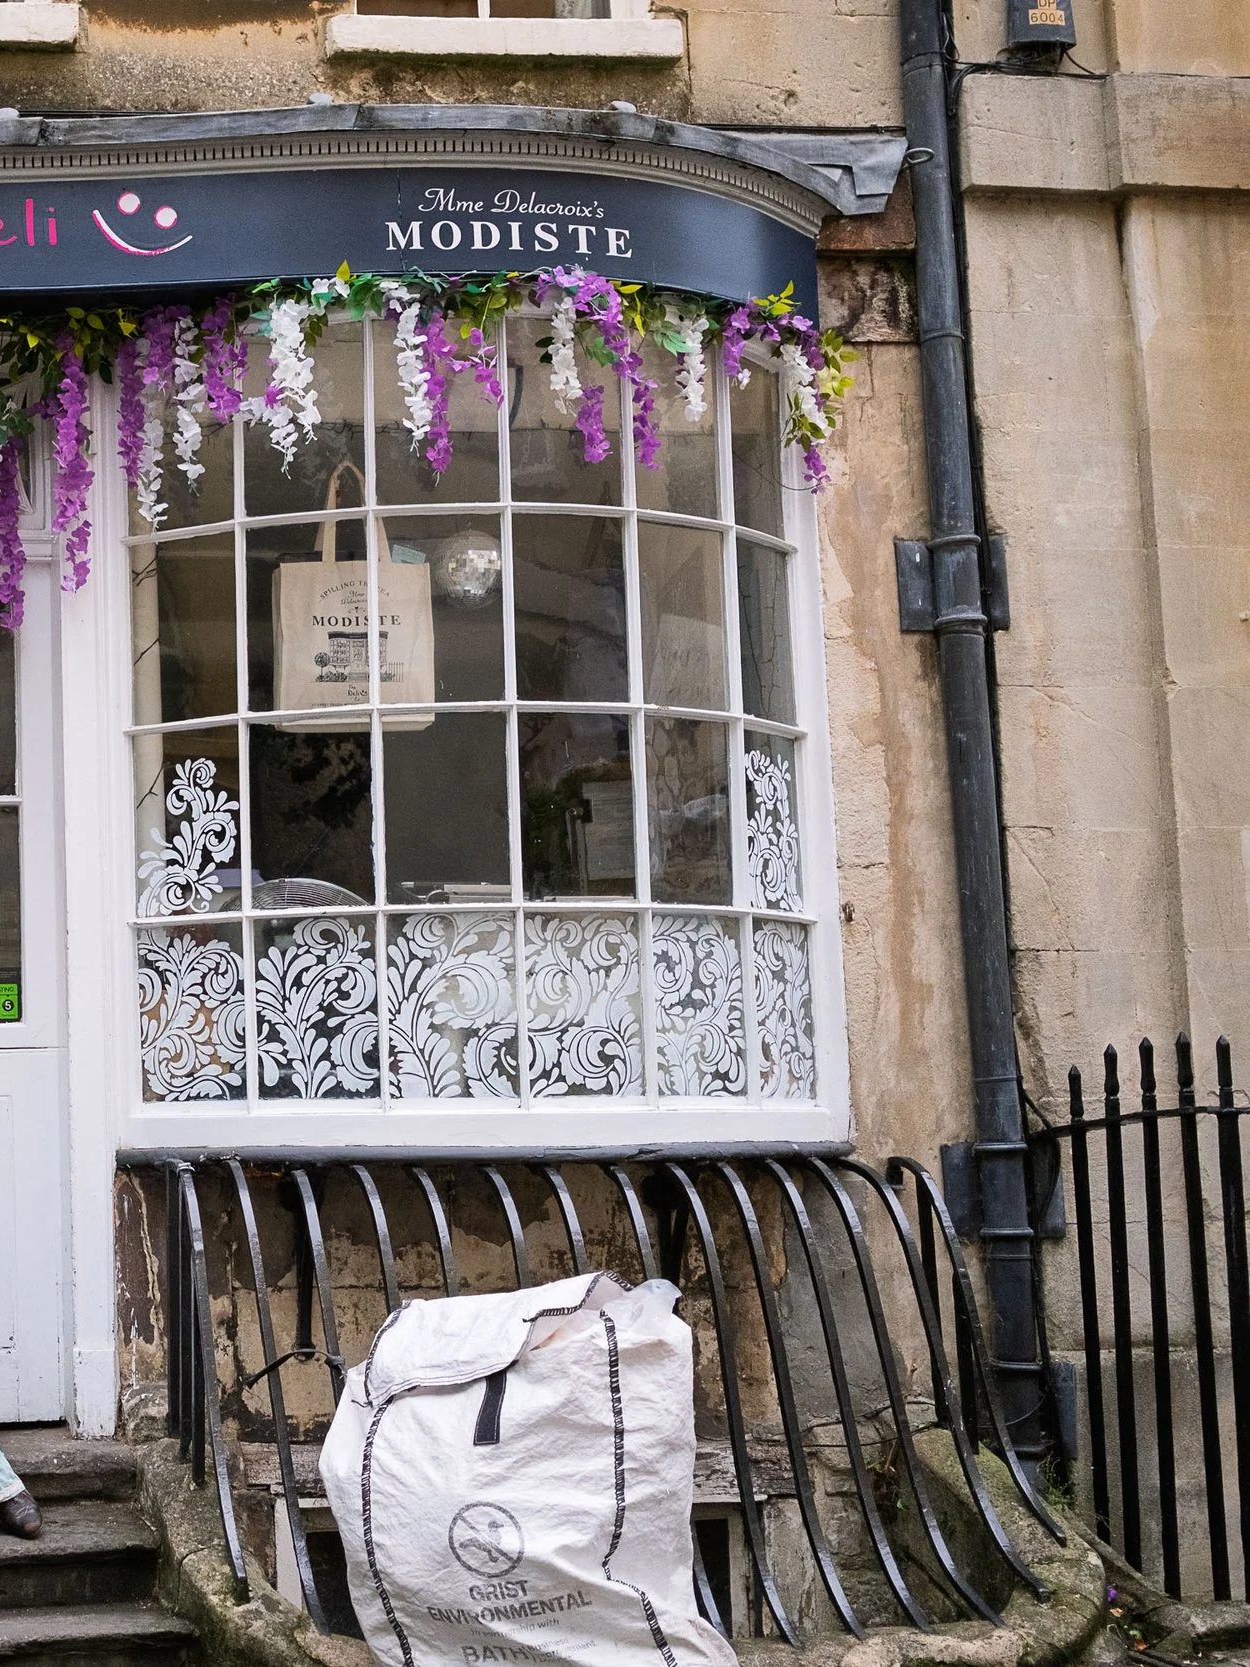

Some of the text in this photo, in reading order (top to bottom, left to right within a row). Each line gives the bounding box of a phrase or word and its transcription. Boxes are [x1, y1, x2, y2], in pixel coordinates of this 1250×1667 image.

[1031, 12, 1063, 23] 6004
[418, 188, 604, 218] Mme Delacroix's
[385, 220, 633, 259] MODISTE
[319, 581, 355, 600] SPILLING
[312, 615, 401, 627] MODISTE
[4, 1001, 12, 1011] 5
[469, 1579, 528, 1602] GRIST
[536, 1618, 560, 1629] with
[461, 1643, 528, 1664] BATH
